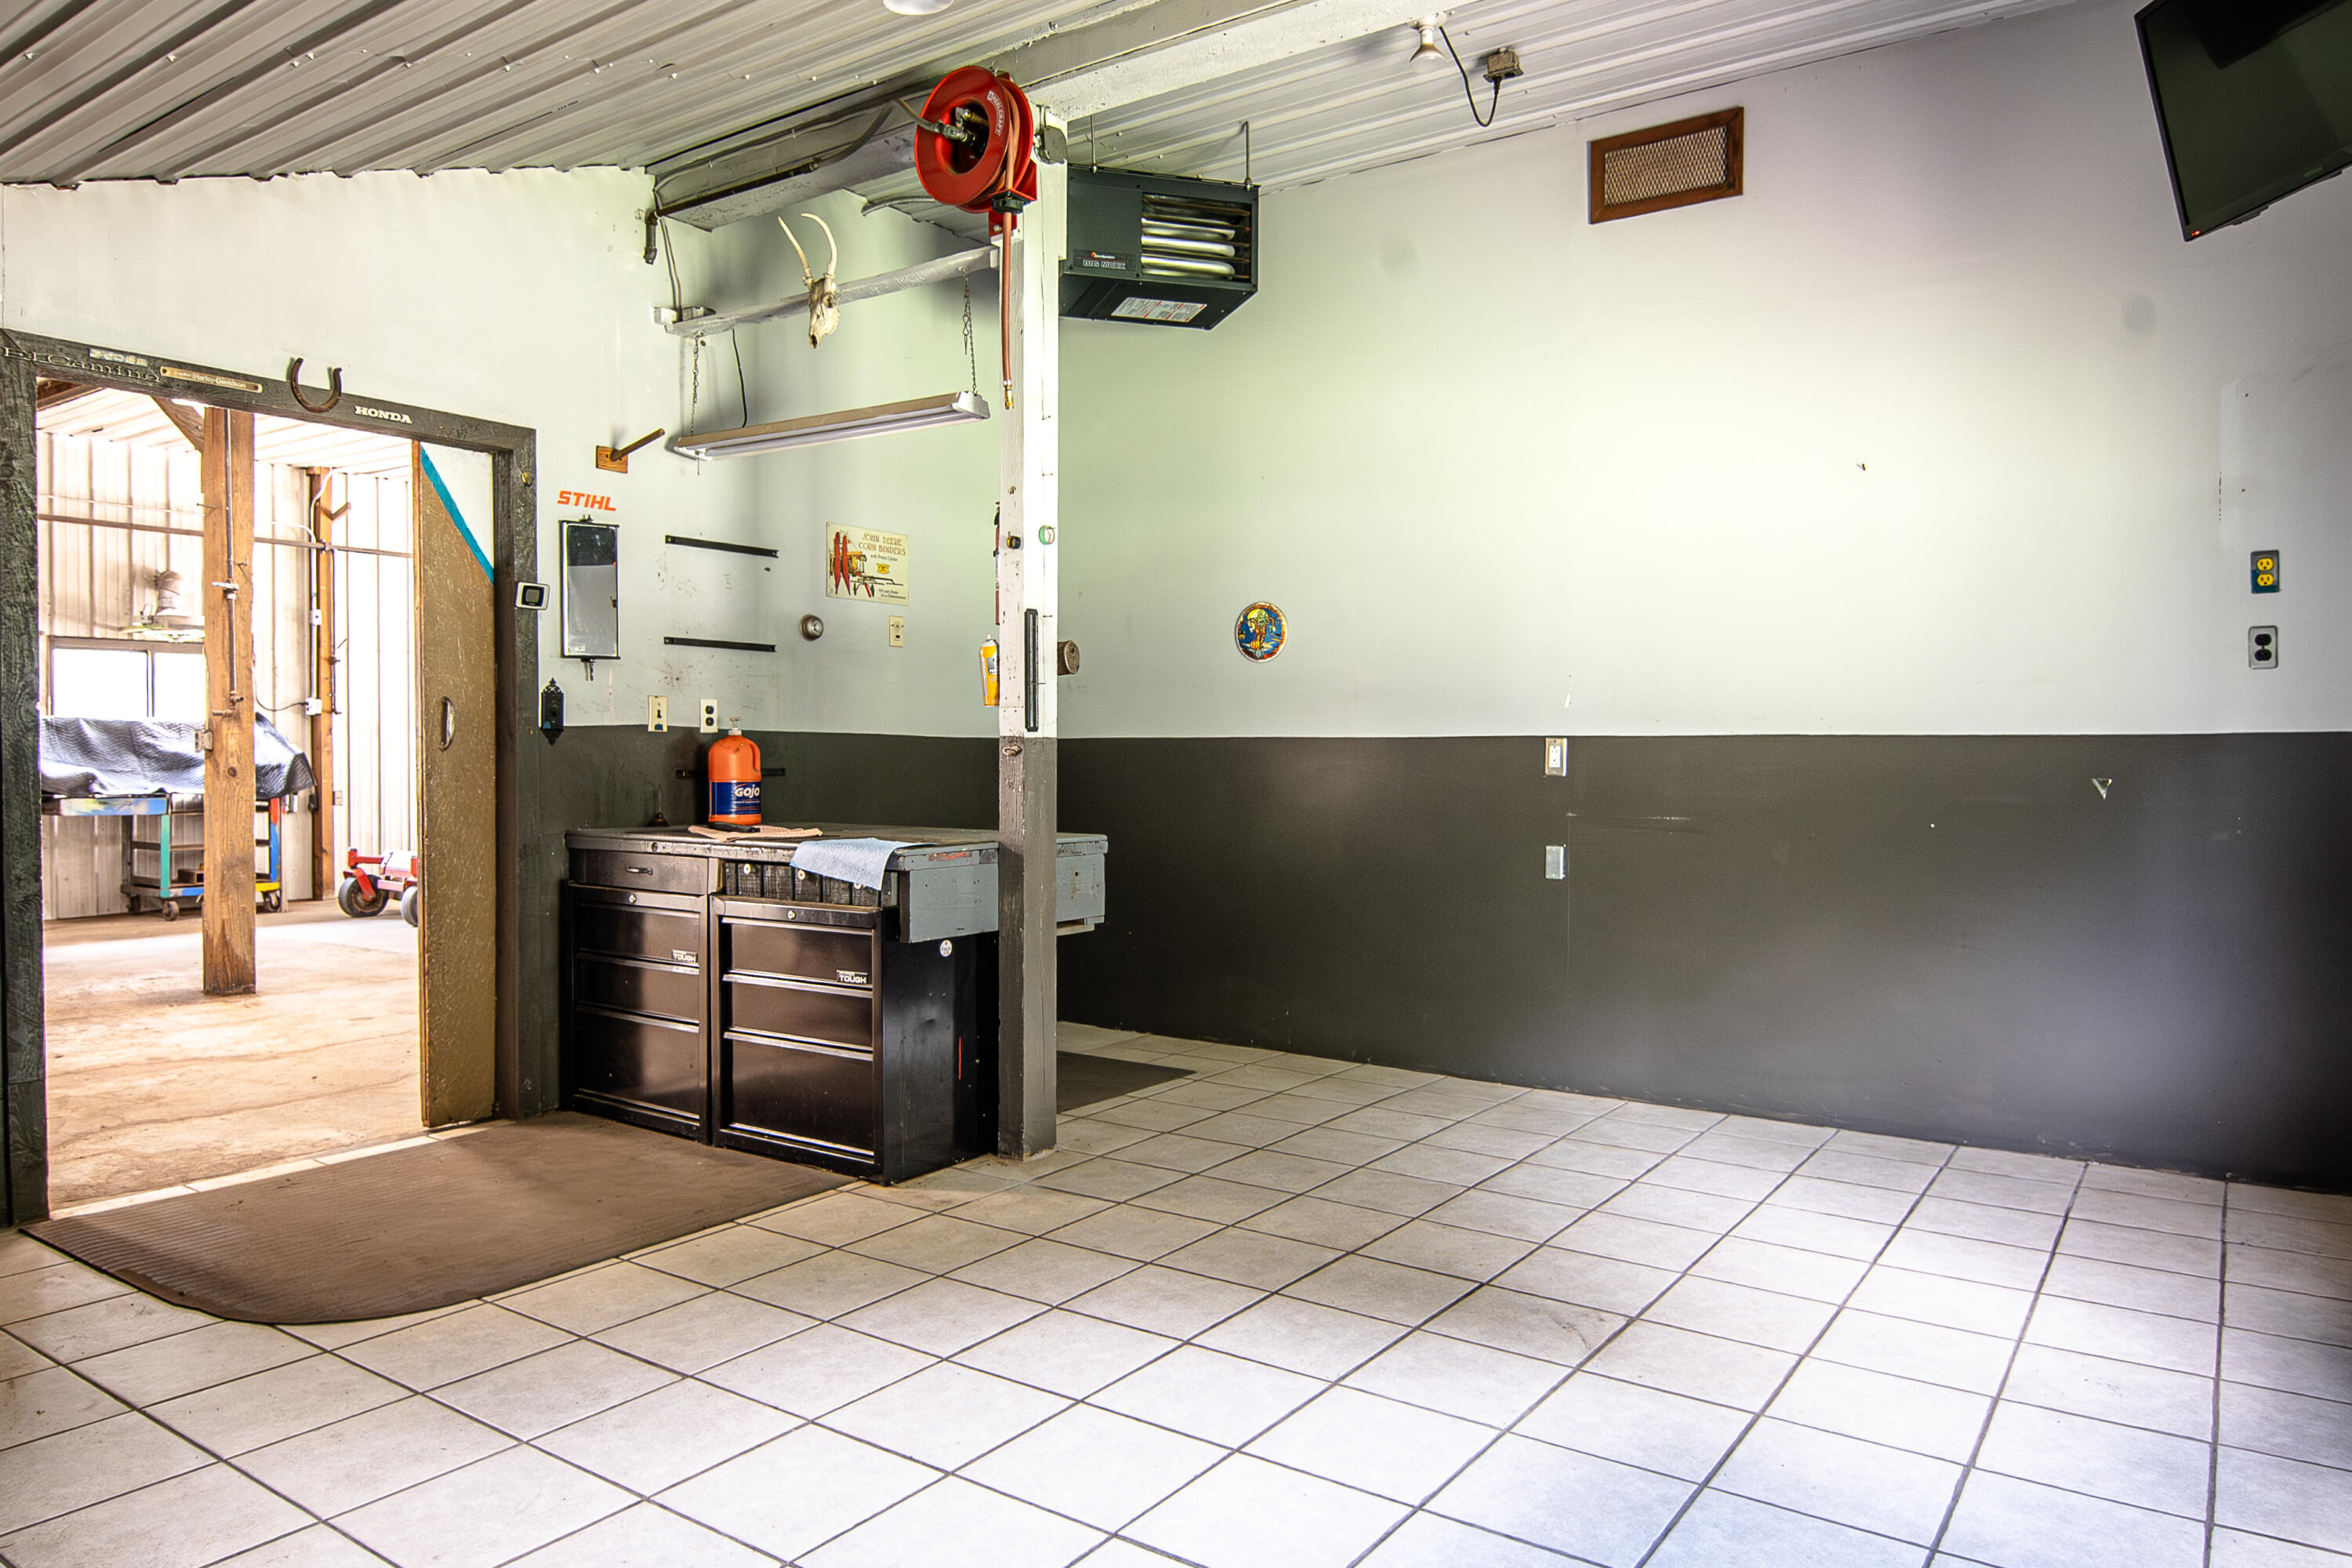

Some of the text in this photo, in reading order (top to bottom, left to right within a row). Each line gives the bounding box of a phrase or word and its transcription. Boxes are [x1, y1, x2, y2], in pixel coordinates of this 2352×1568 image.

[354, 405, 412, 424] HONDA
[557, 490, 617, 511] STIHL
[862, 533, 902, 546] JOHN DEERE
[858, 542, 906, 556] CORN BINDERS
[673, 953, 696, 963] TOUGH
[840, 975, 867, 984] TOUGH
